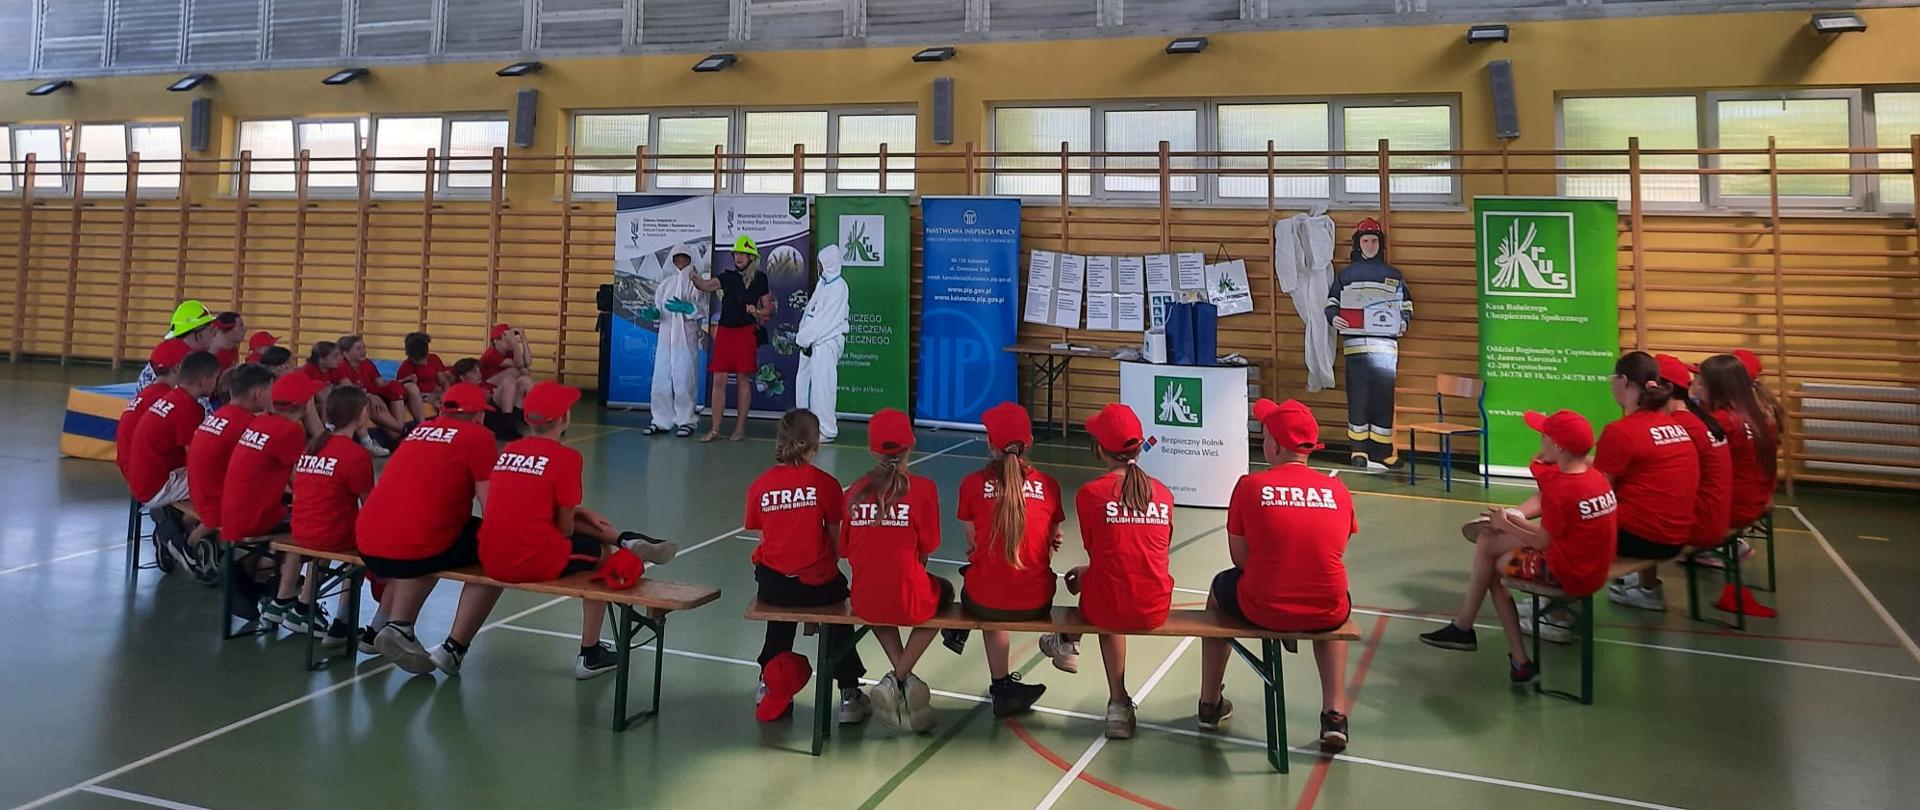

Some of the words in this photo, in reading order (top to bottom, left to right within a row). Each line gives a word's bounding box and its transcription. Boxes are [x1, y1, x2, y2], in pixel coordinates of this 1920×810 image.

[1161, 435, 1200, 446] Bezpieczny
[1202, 438, 1224, 446] Rolnik
[1161, 445, 1200, 456] Bezpieczna
